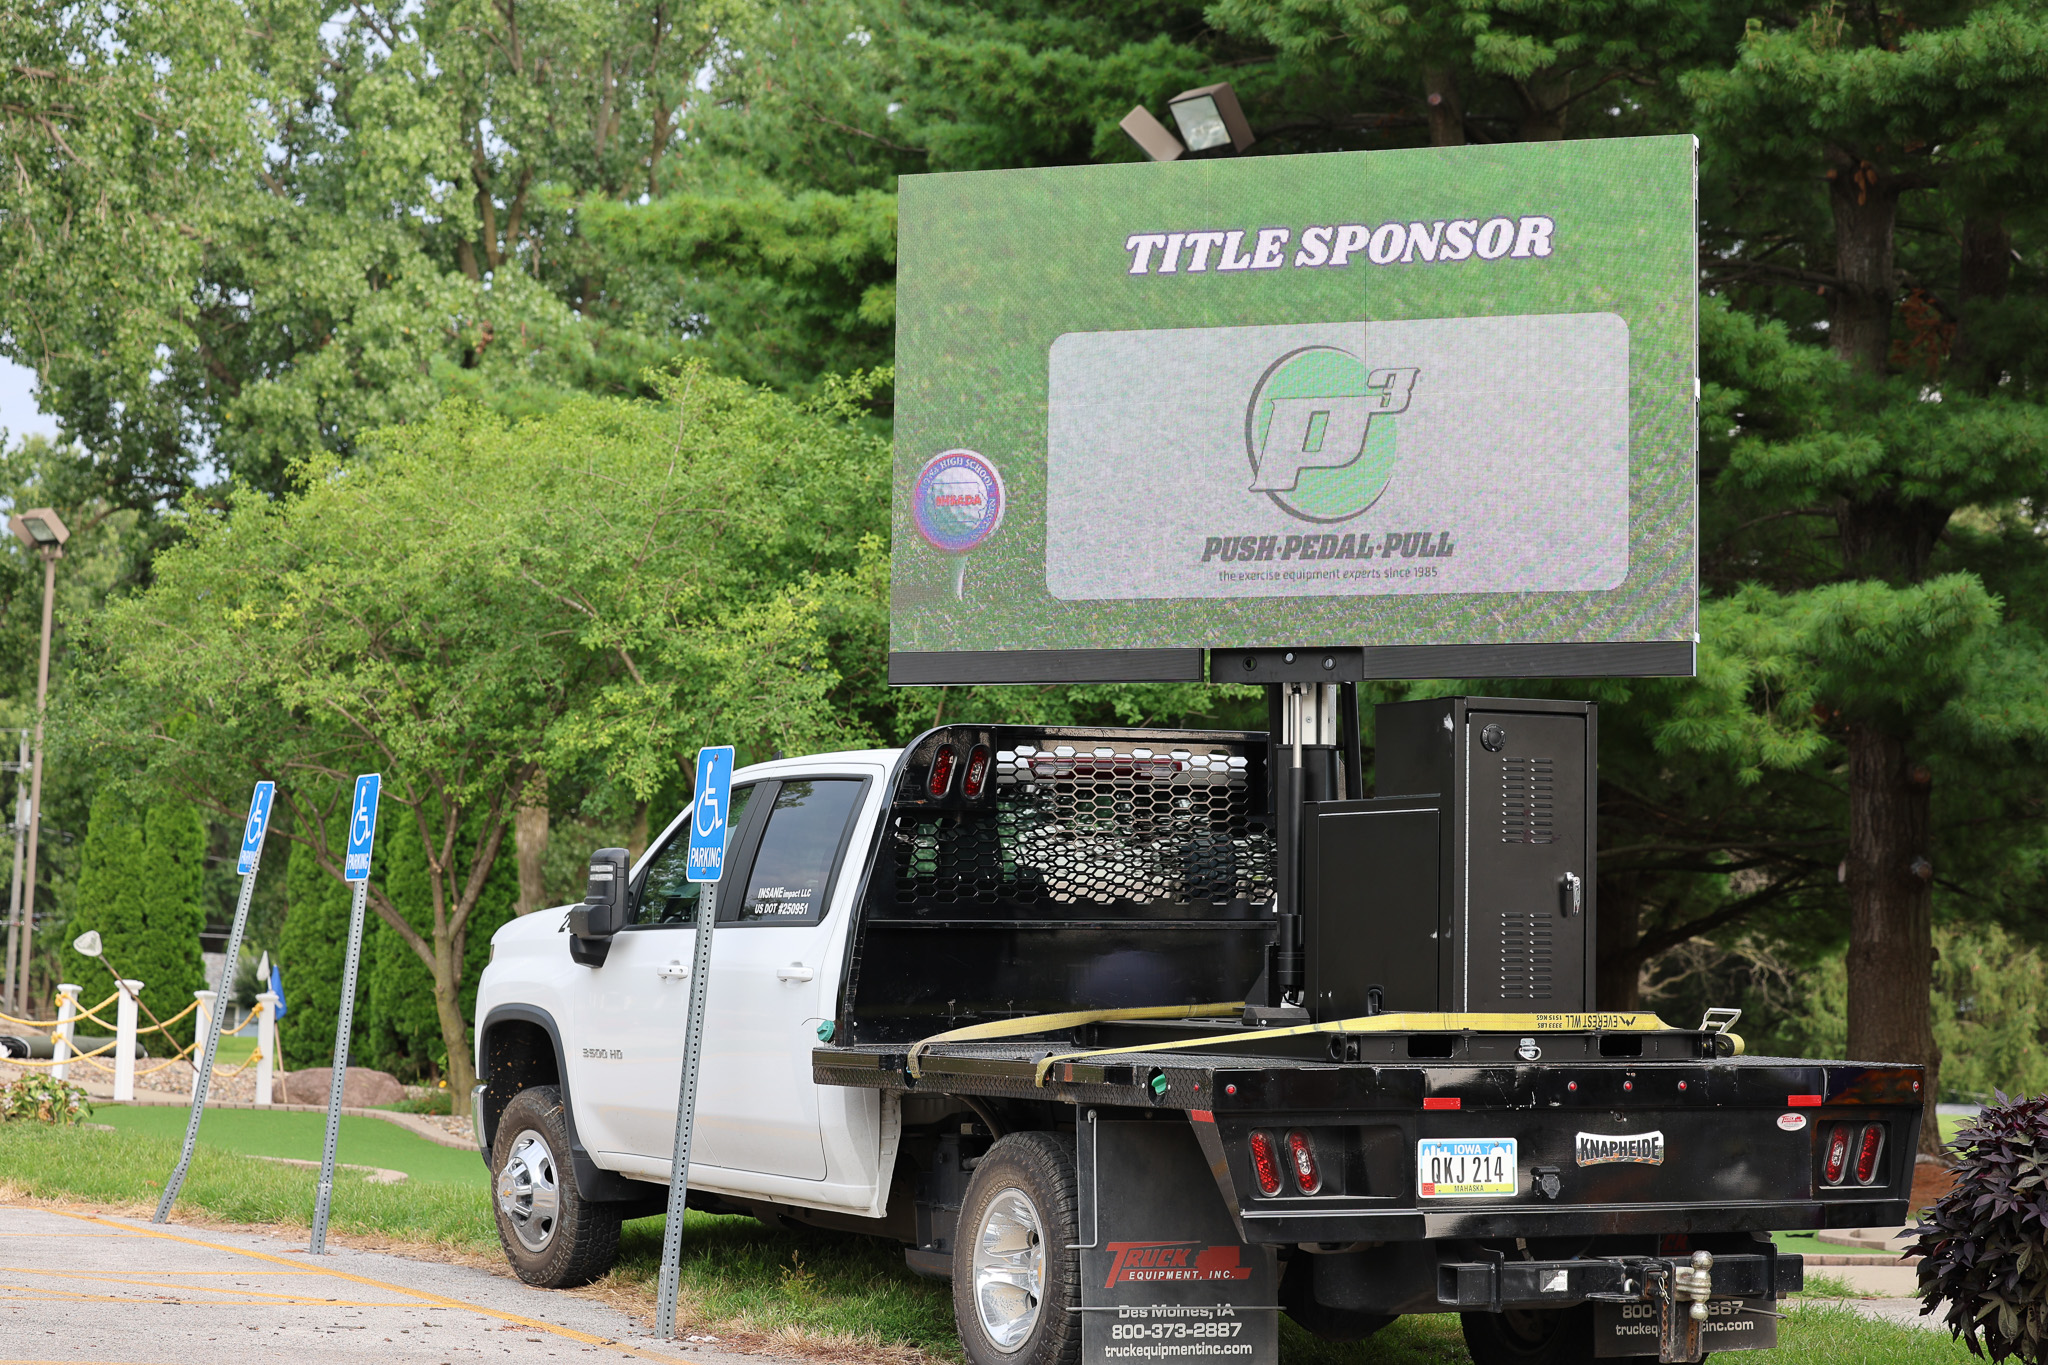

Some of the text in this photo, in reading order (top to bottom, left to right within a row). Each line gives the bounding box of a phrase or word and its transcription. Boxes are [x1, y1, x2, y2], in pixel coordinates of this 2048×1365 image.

[1125, 215, 1556, 274] TITLE SPONSOR
[940, 457, 963, 469] HIGH
[1219, 566, 1438, 582] the exercise equipment experts since 1985
[347, 853, 369, 870] PARKING
[690, 847, 721, 868] PARKING
[758, 887, 812, 900] INSANE impact LLC
[755, 902, 809, 915] US DOT #250951
[1565, 1014, 1618, 1028] EVEREST WLL
[583, 1048, 623, 1059] 3500 HD
[1454, 1144, 1482, 1155] IOWA
[1580, 1136, 1660, 1161] KNAPHEIDE
[1431, 1156, 1503, 1184] QKJ 214
[1454, 1185, 1484, 1193] MAHASKA
[1105, 1241, 1201, 1288] TRUCK
[1129, 1270, 1235, 1281] EQUIPMENT, INC.
[1118, 1303, 1235, 1320] Des Moines, IA
[1112, 1322, 1242, 1340] 800-373-2887
[1105, 1342, 1253, 1359] truckequipmentinc.com
